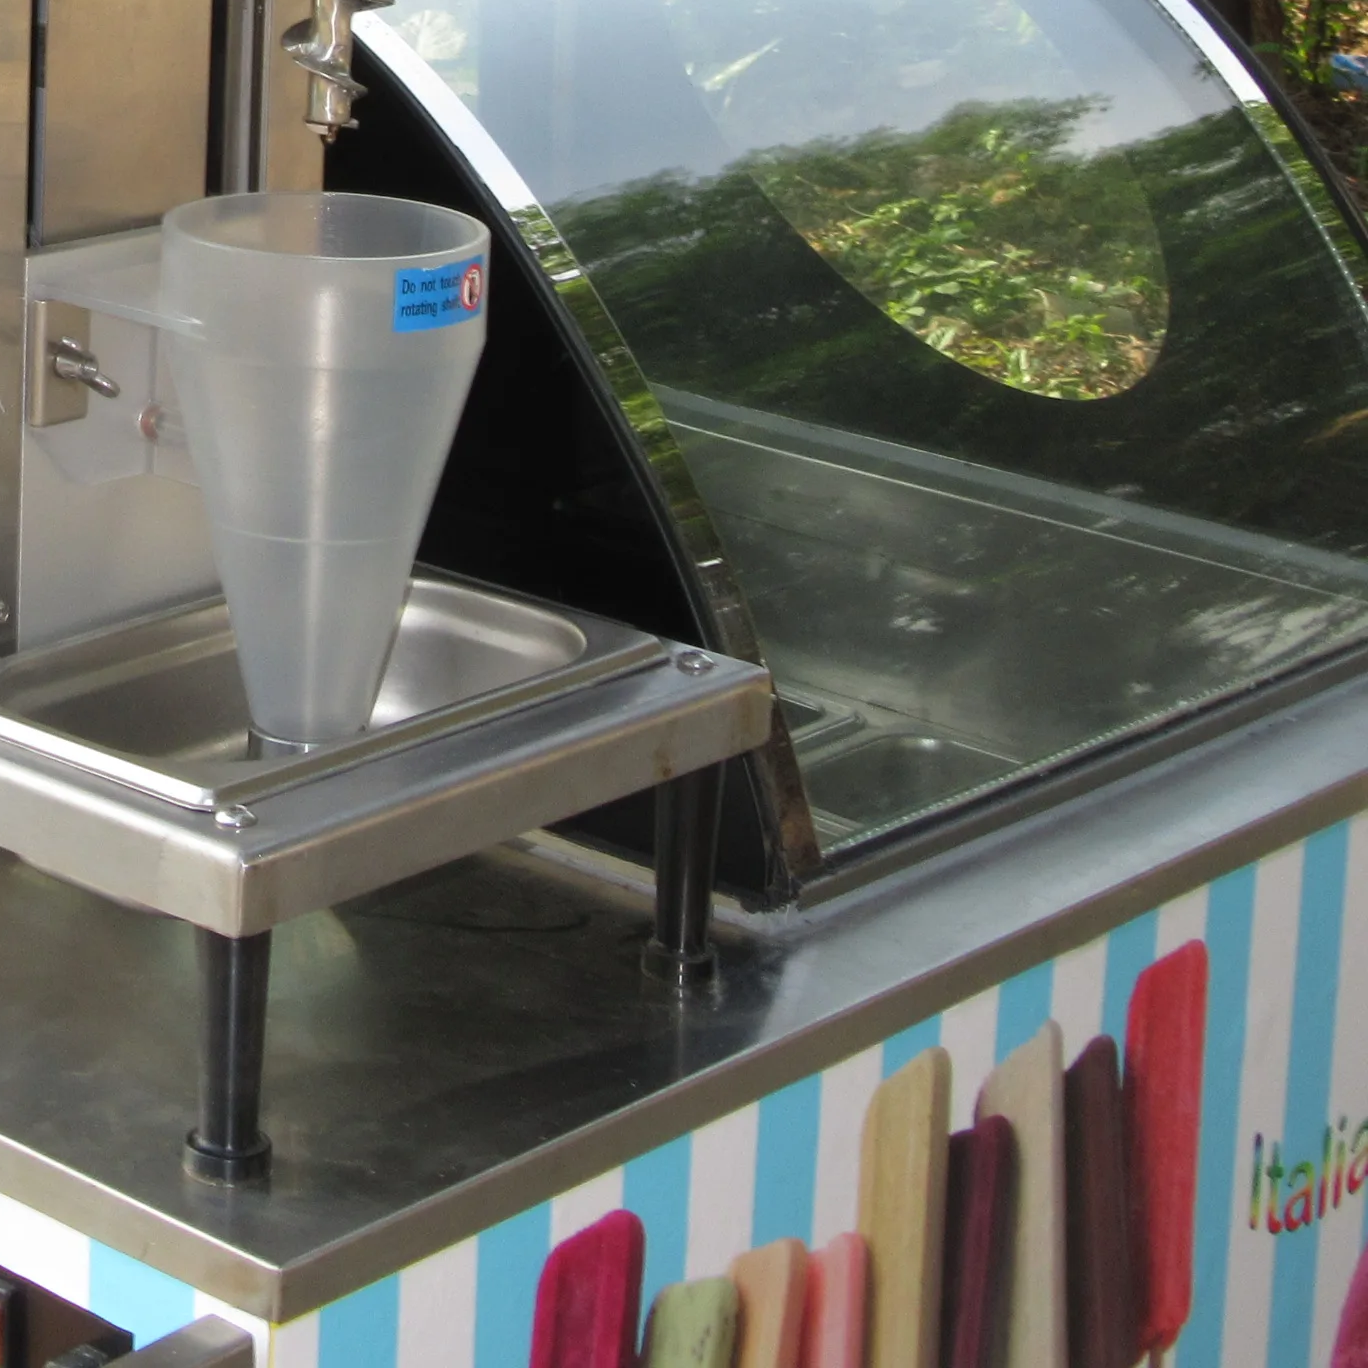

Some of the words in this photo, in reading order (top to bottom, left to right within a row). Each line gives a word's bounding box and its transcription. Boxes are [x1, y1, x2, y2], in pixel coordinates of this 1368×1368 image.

[402, 279, 416, 294] Do
[421, 279, 436, 292] not
[401, 300, 438, 317] rotating
